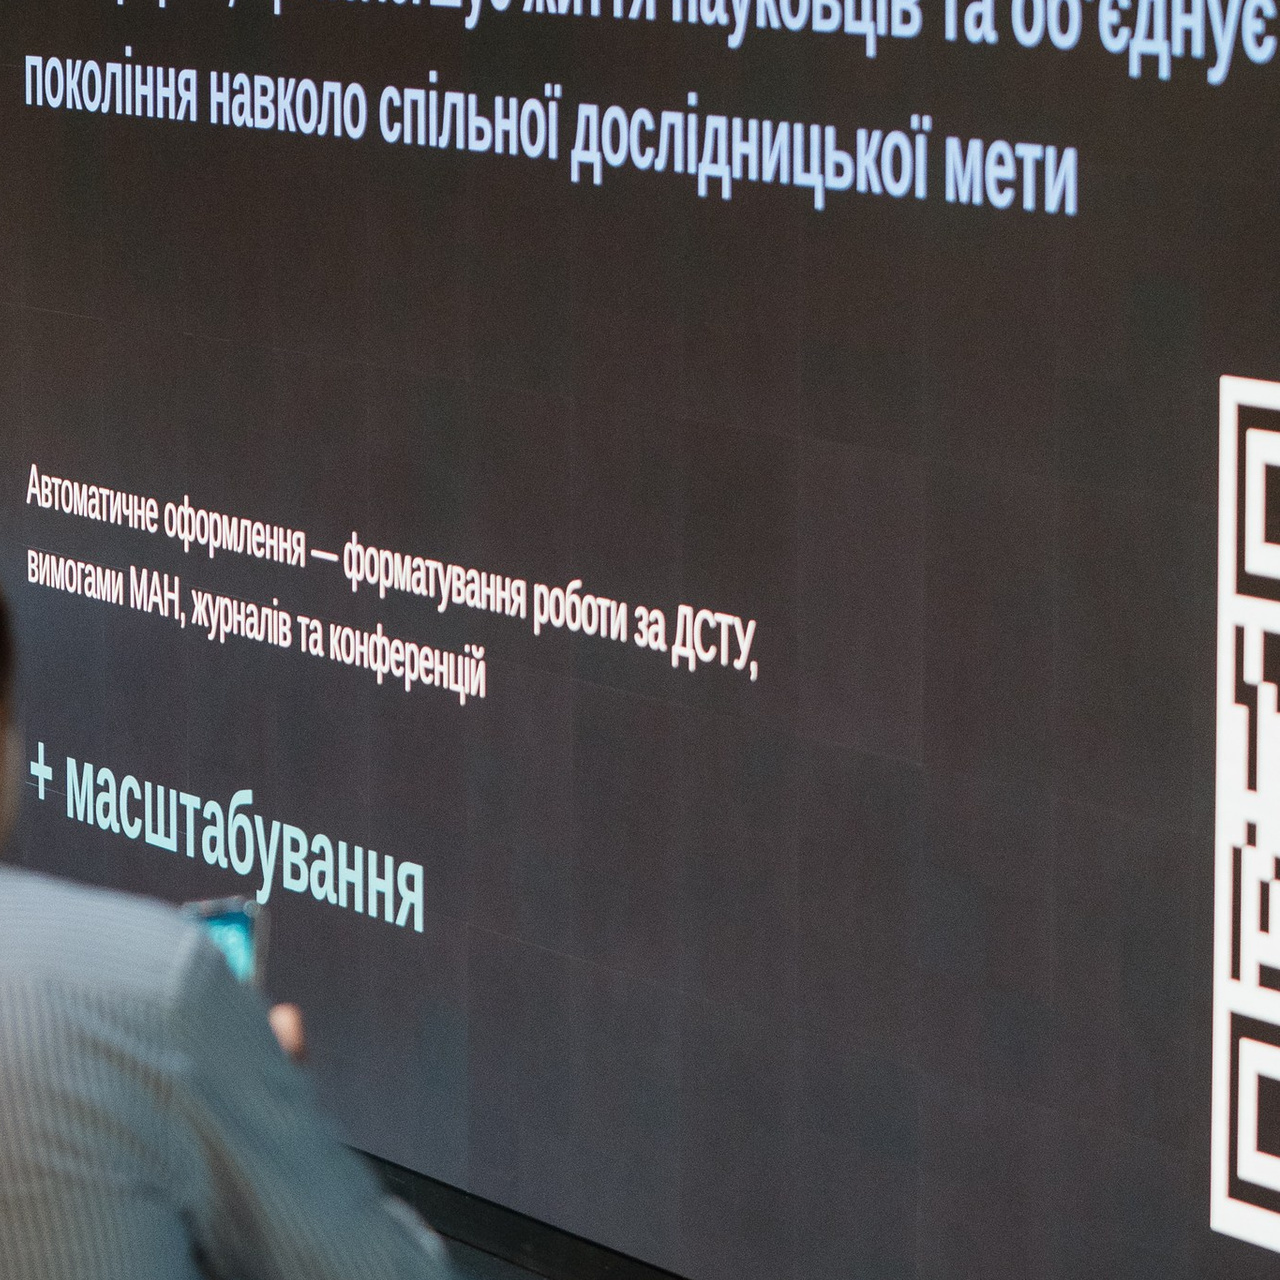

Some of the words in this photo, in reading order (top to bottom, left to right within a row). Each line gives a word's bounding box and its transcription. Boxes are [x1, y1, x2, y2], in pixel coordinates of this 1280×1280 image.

[25, 45, 199, 123] покоління
[209, 69, 369, 141] навколо
[378, 70, 562, 161] спільної
[569, 90, 933, 212] дослідницької
[944, 135, 1079, 217] мети
[24, 463, 161, 535] Автоматичне
[162, 494, 307, 569] оформлення
[342, 530, 528, 620] форматування
[532, 578, 629, 644] роботи
[633, 605, 669, 653] за
[669, 603, 760, 683] ДСТУ,
[26, 547, 125, 607] вимогами
[128, 563, 187, 630] МАН,
[190, 589, 294, 650] журналів
[296, 614, 325, 658] та
[328, 622, 488, 708] конференцій
[28, 740, 54, 802] +
[65, 755, 425, 934] масштабування
